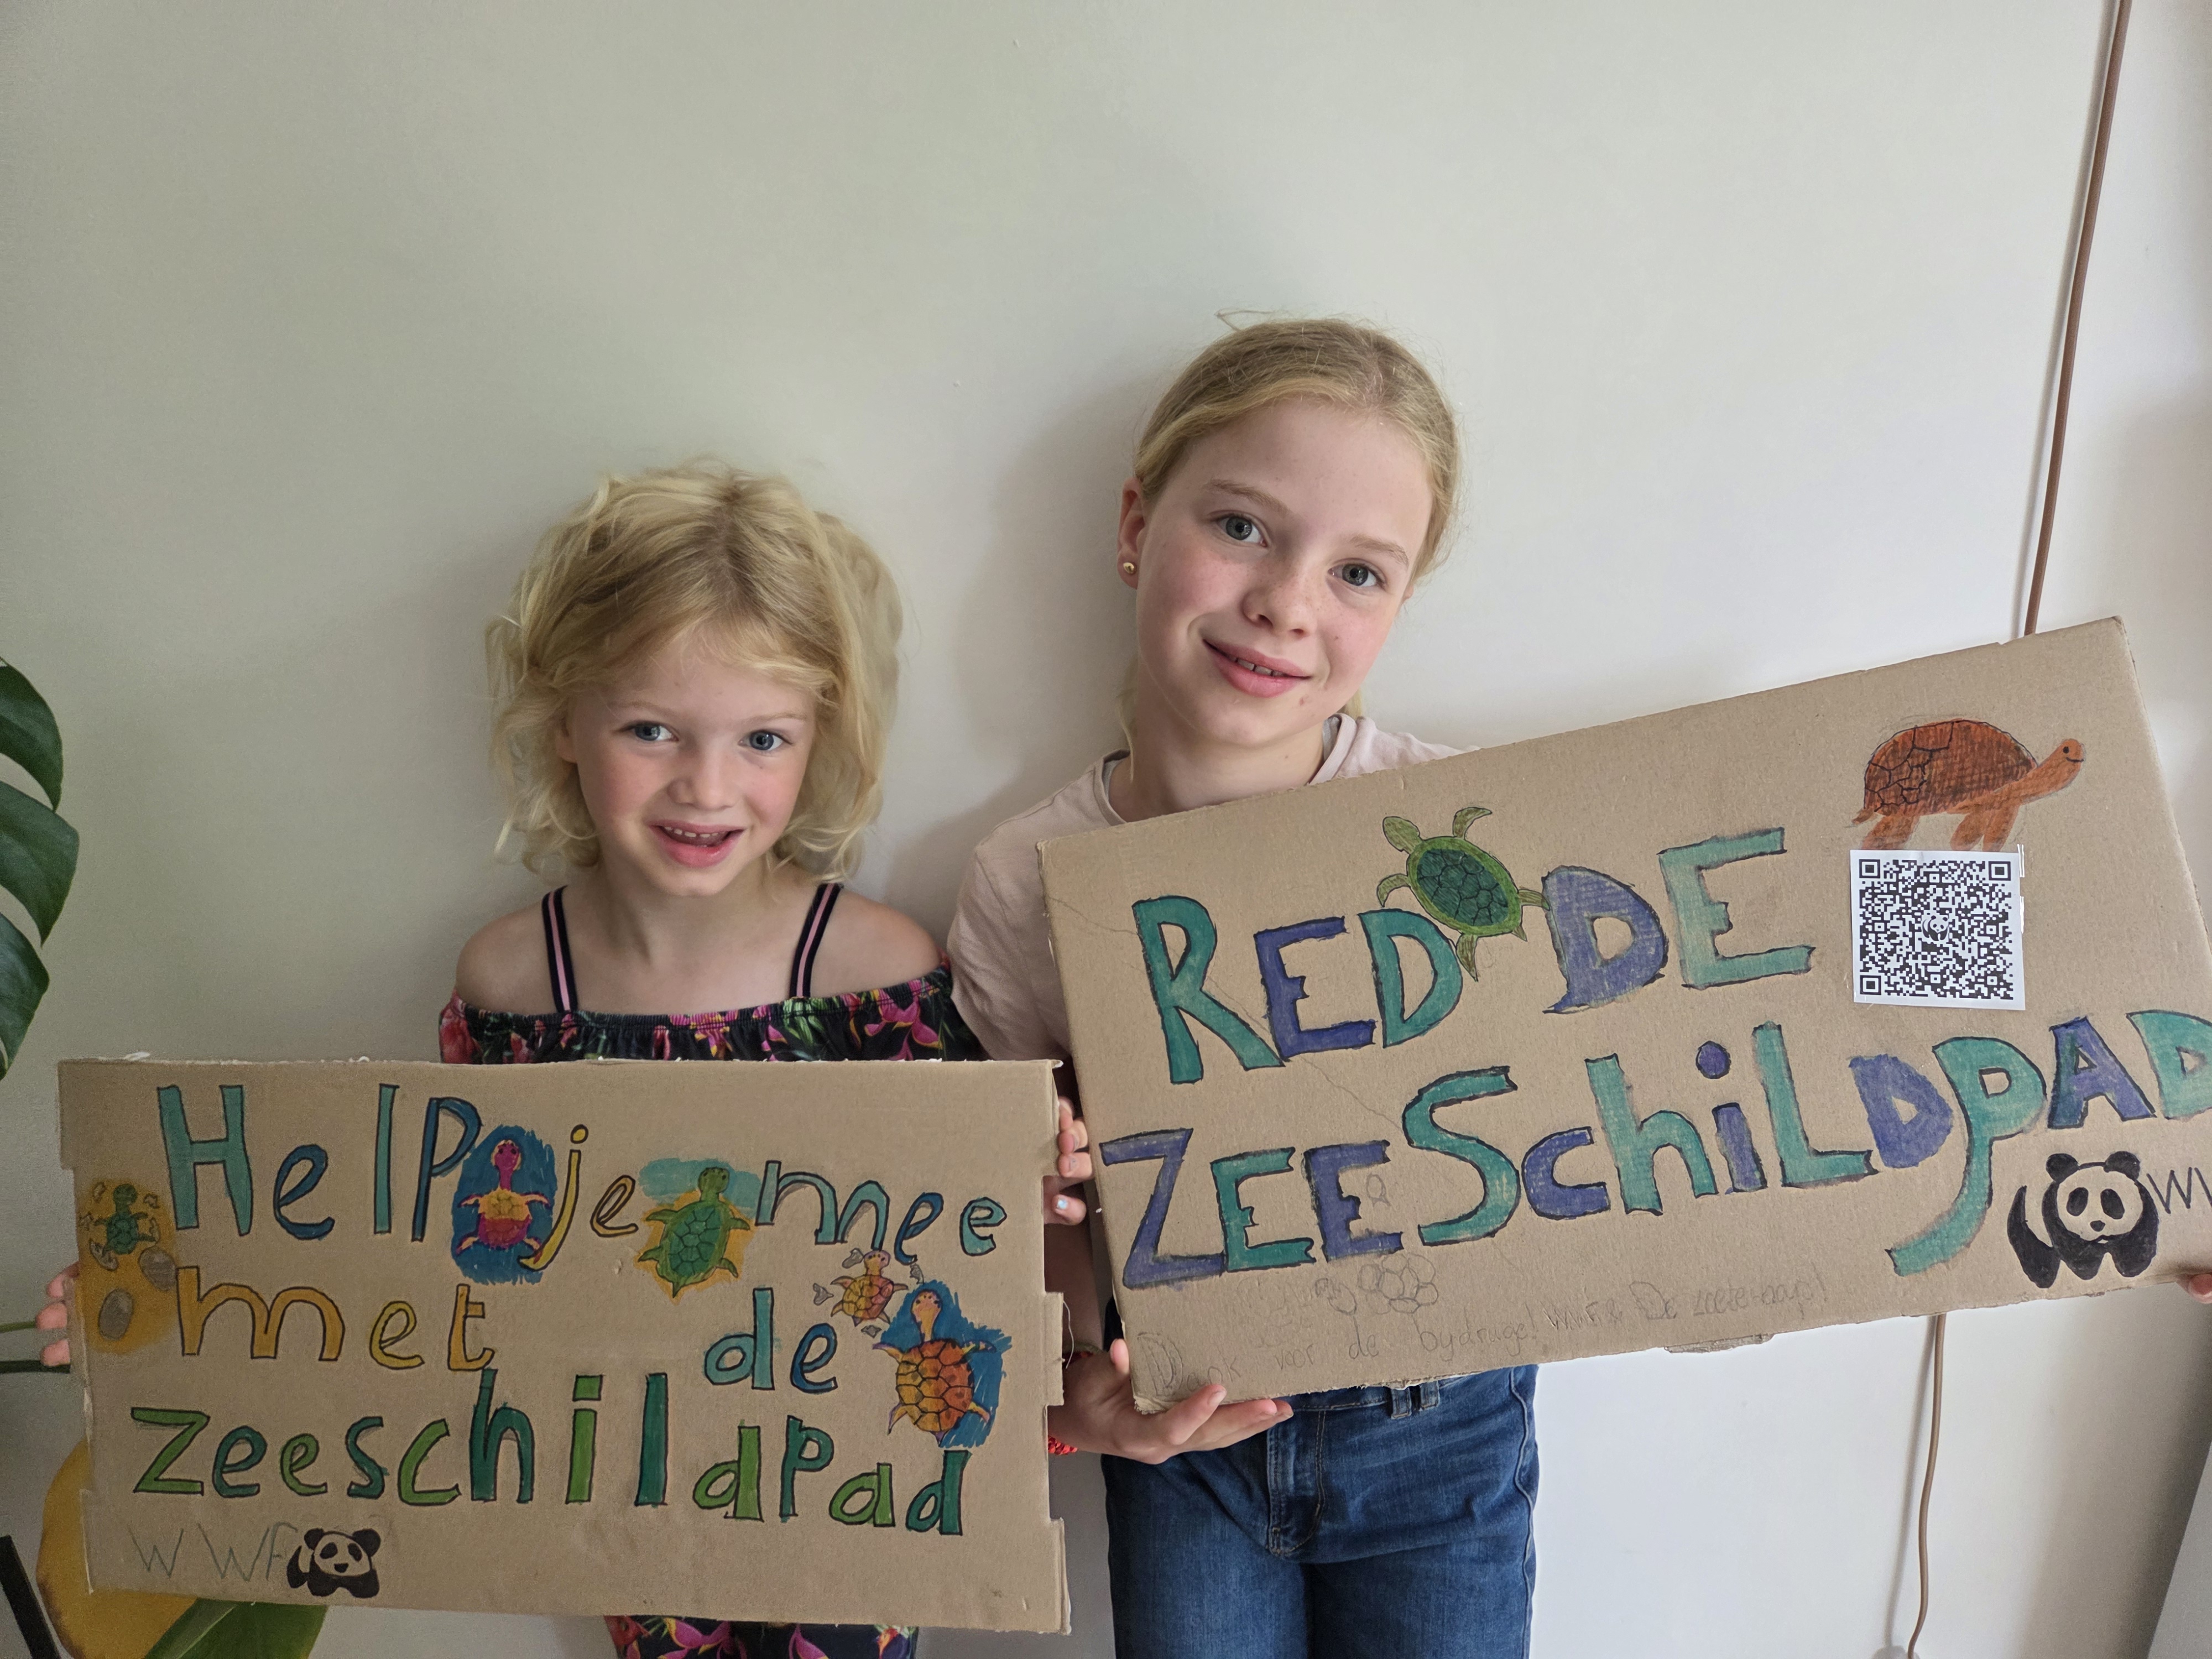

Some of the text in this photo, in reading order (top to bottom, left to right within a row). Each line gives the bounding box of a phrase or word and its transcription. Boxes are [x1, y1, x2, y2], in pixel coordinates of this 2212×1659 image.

[1131, 827, 1816, 1084] RED DE
[518, 1124, 639, 1271] je
[755, 1160, 1007, 1265] mee
[175, 1266, 838, 1394] met de
[1348, 1316, 1380, 1360] de
[126, 1520, 299, 1583] WWF
